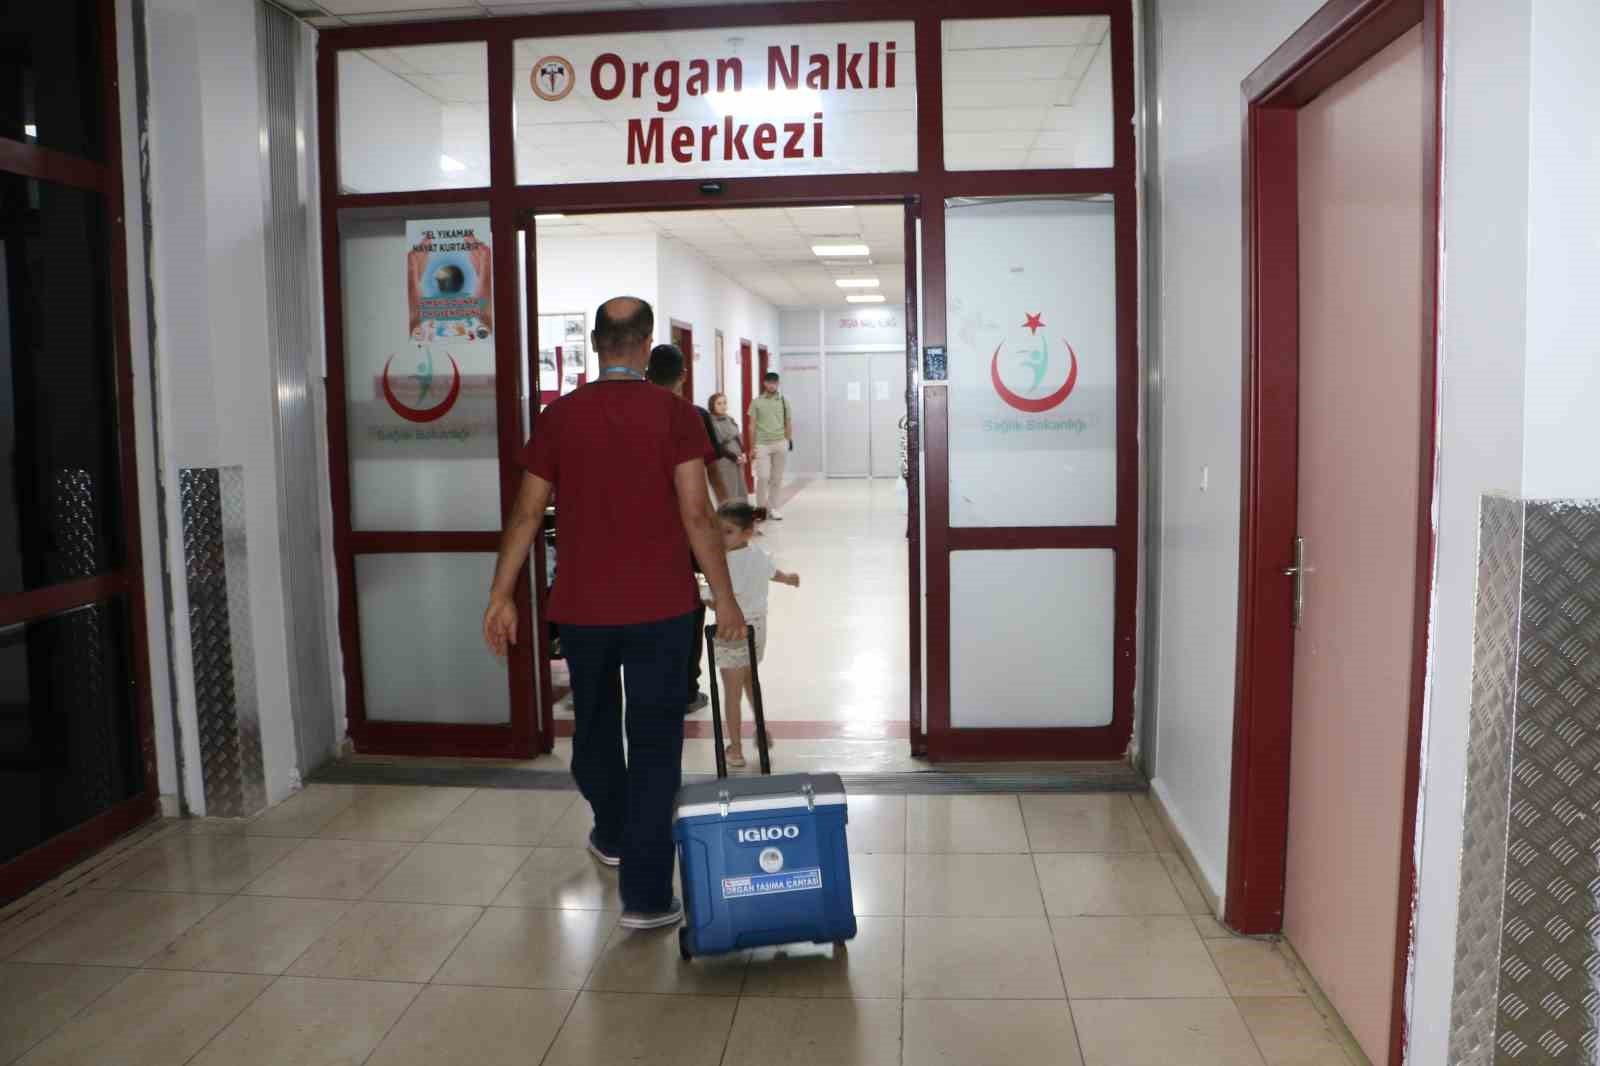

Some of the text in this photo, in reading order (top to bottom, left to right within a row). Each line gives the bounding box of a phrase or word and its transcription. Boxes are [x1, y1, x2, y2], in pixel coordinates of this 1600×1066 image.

[590, 41, 897, 112] Organ Nakli
[626, 112, 823, 165] Merkezi
[738, 825, 799, 843] IGLOO
